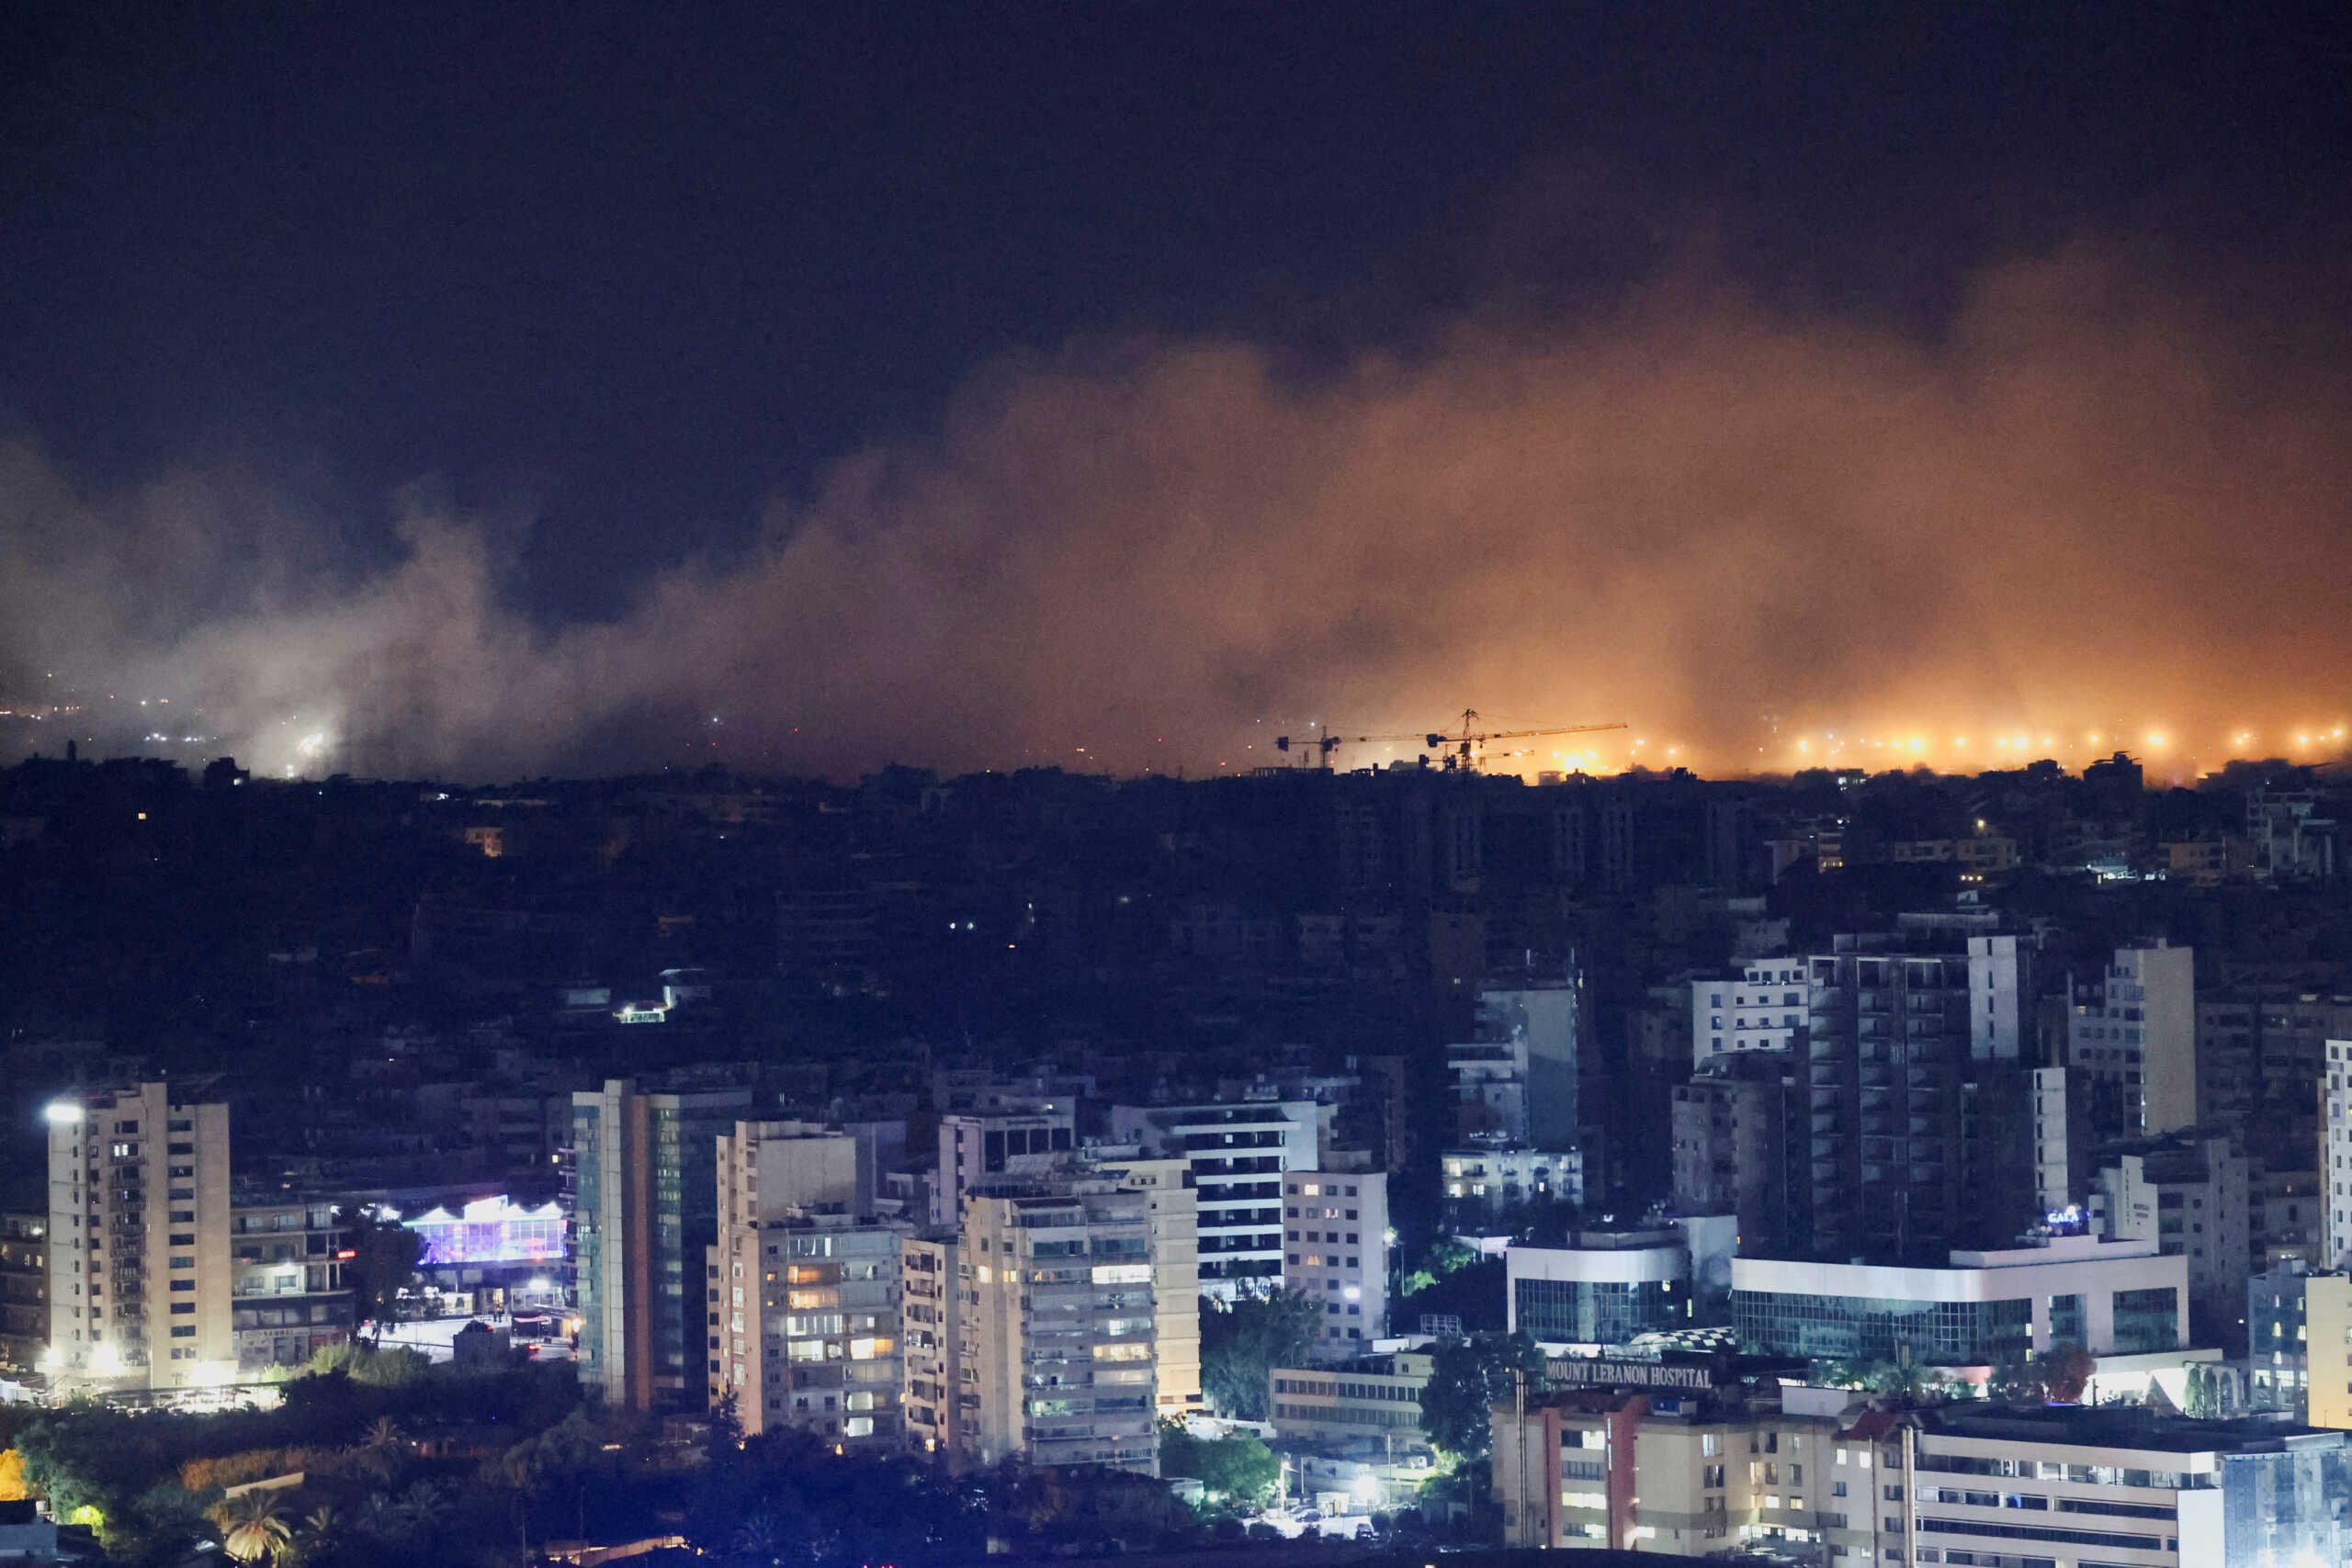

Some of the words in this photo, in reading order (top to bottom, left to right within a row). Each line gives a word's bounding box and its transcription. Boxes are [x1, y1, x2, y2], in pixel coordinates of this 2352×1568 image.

[1547, 1362, 1589, 1382] MOUNT
[1594, 1365, 1647, 1384] LEBANON
[1651, 1368, 1712, 1388] HOSPITAL
